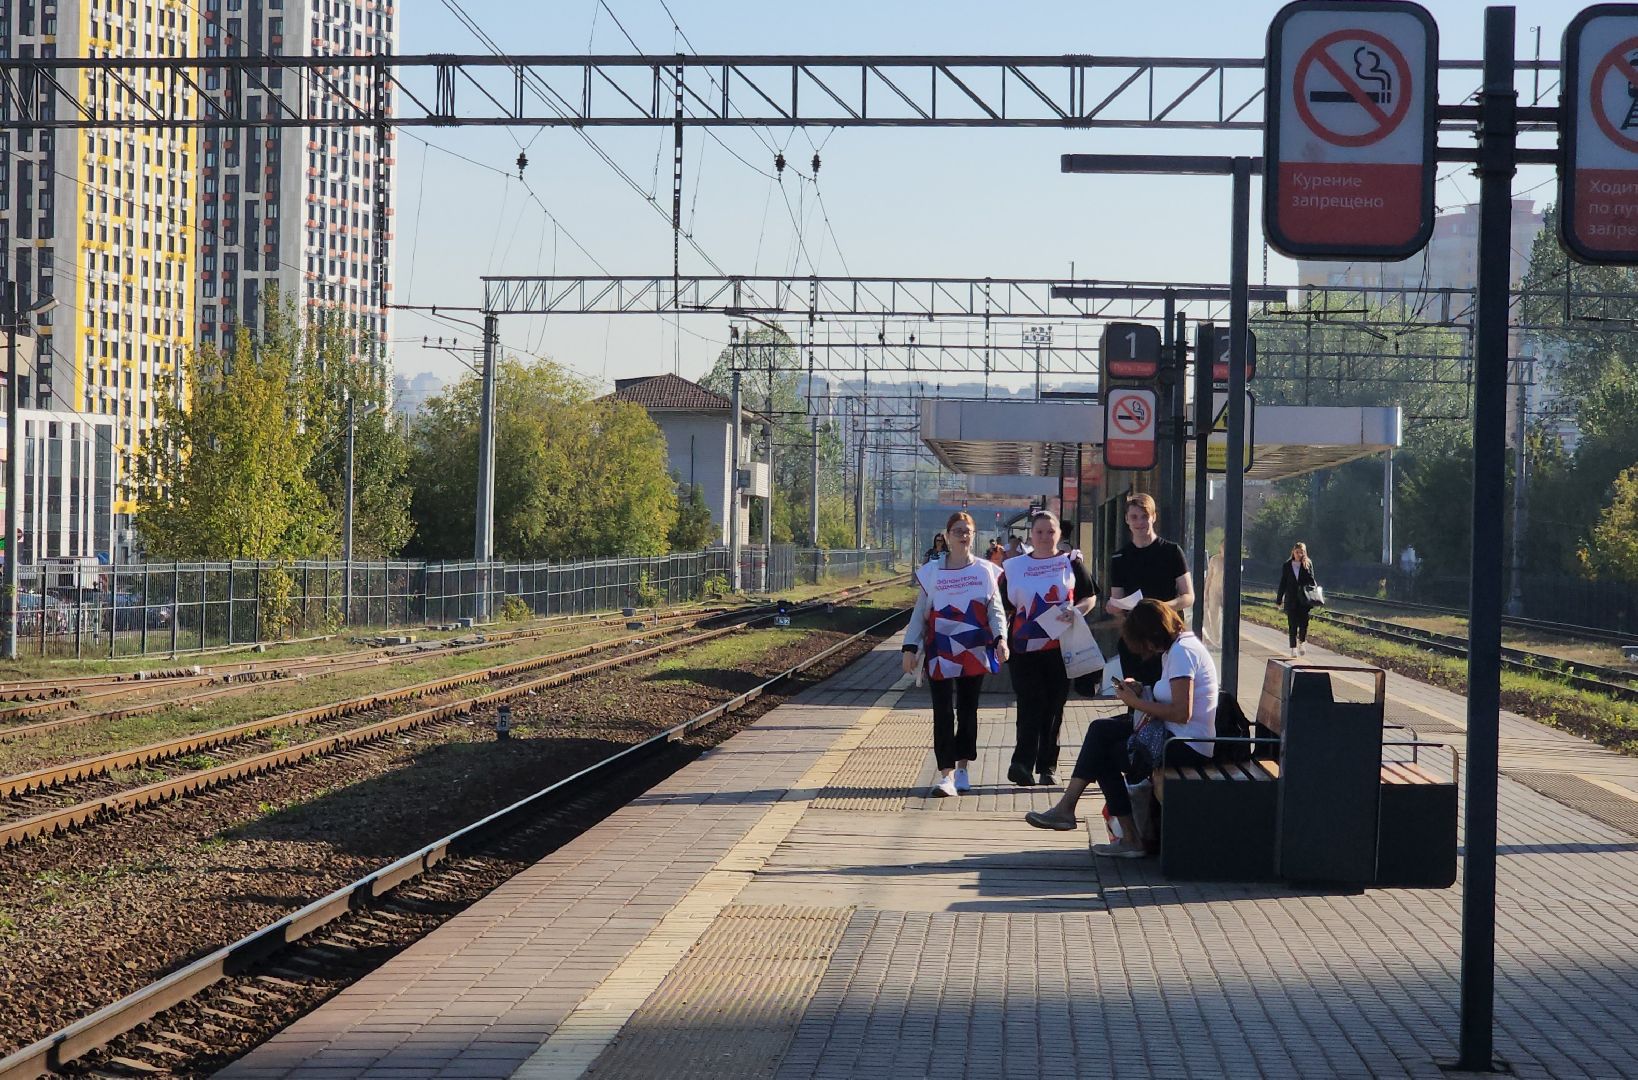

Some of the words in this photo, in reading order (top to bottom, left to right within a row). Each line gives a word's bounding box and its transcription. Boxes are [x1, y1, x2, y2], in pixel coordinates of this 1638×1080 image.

[1292, 172, 1362, 190] Курение
[1292, 195, 1384, 210] запрещено
[1589, 203, 1609, 215] по
[1125, 332, 1136, 359] 1
[501, 715, 507, 727] 6
